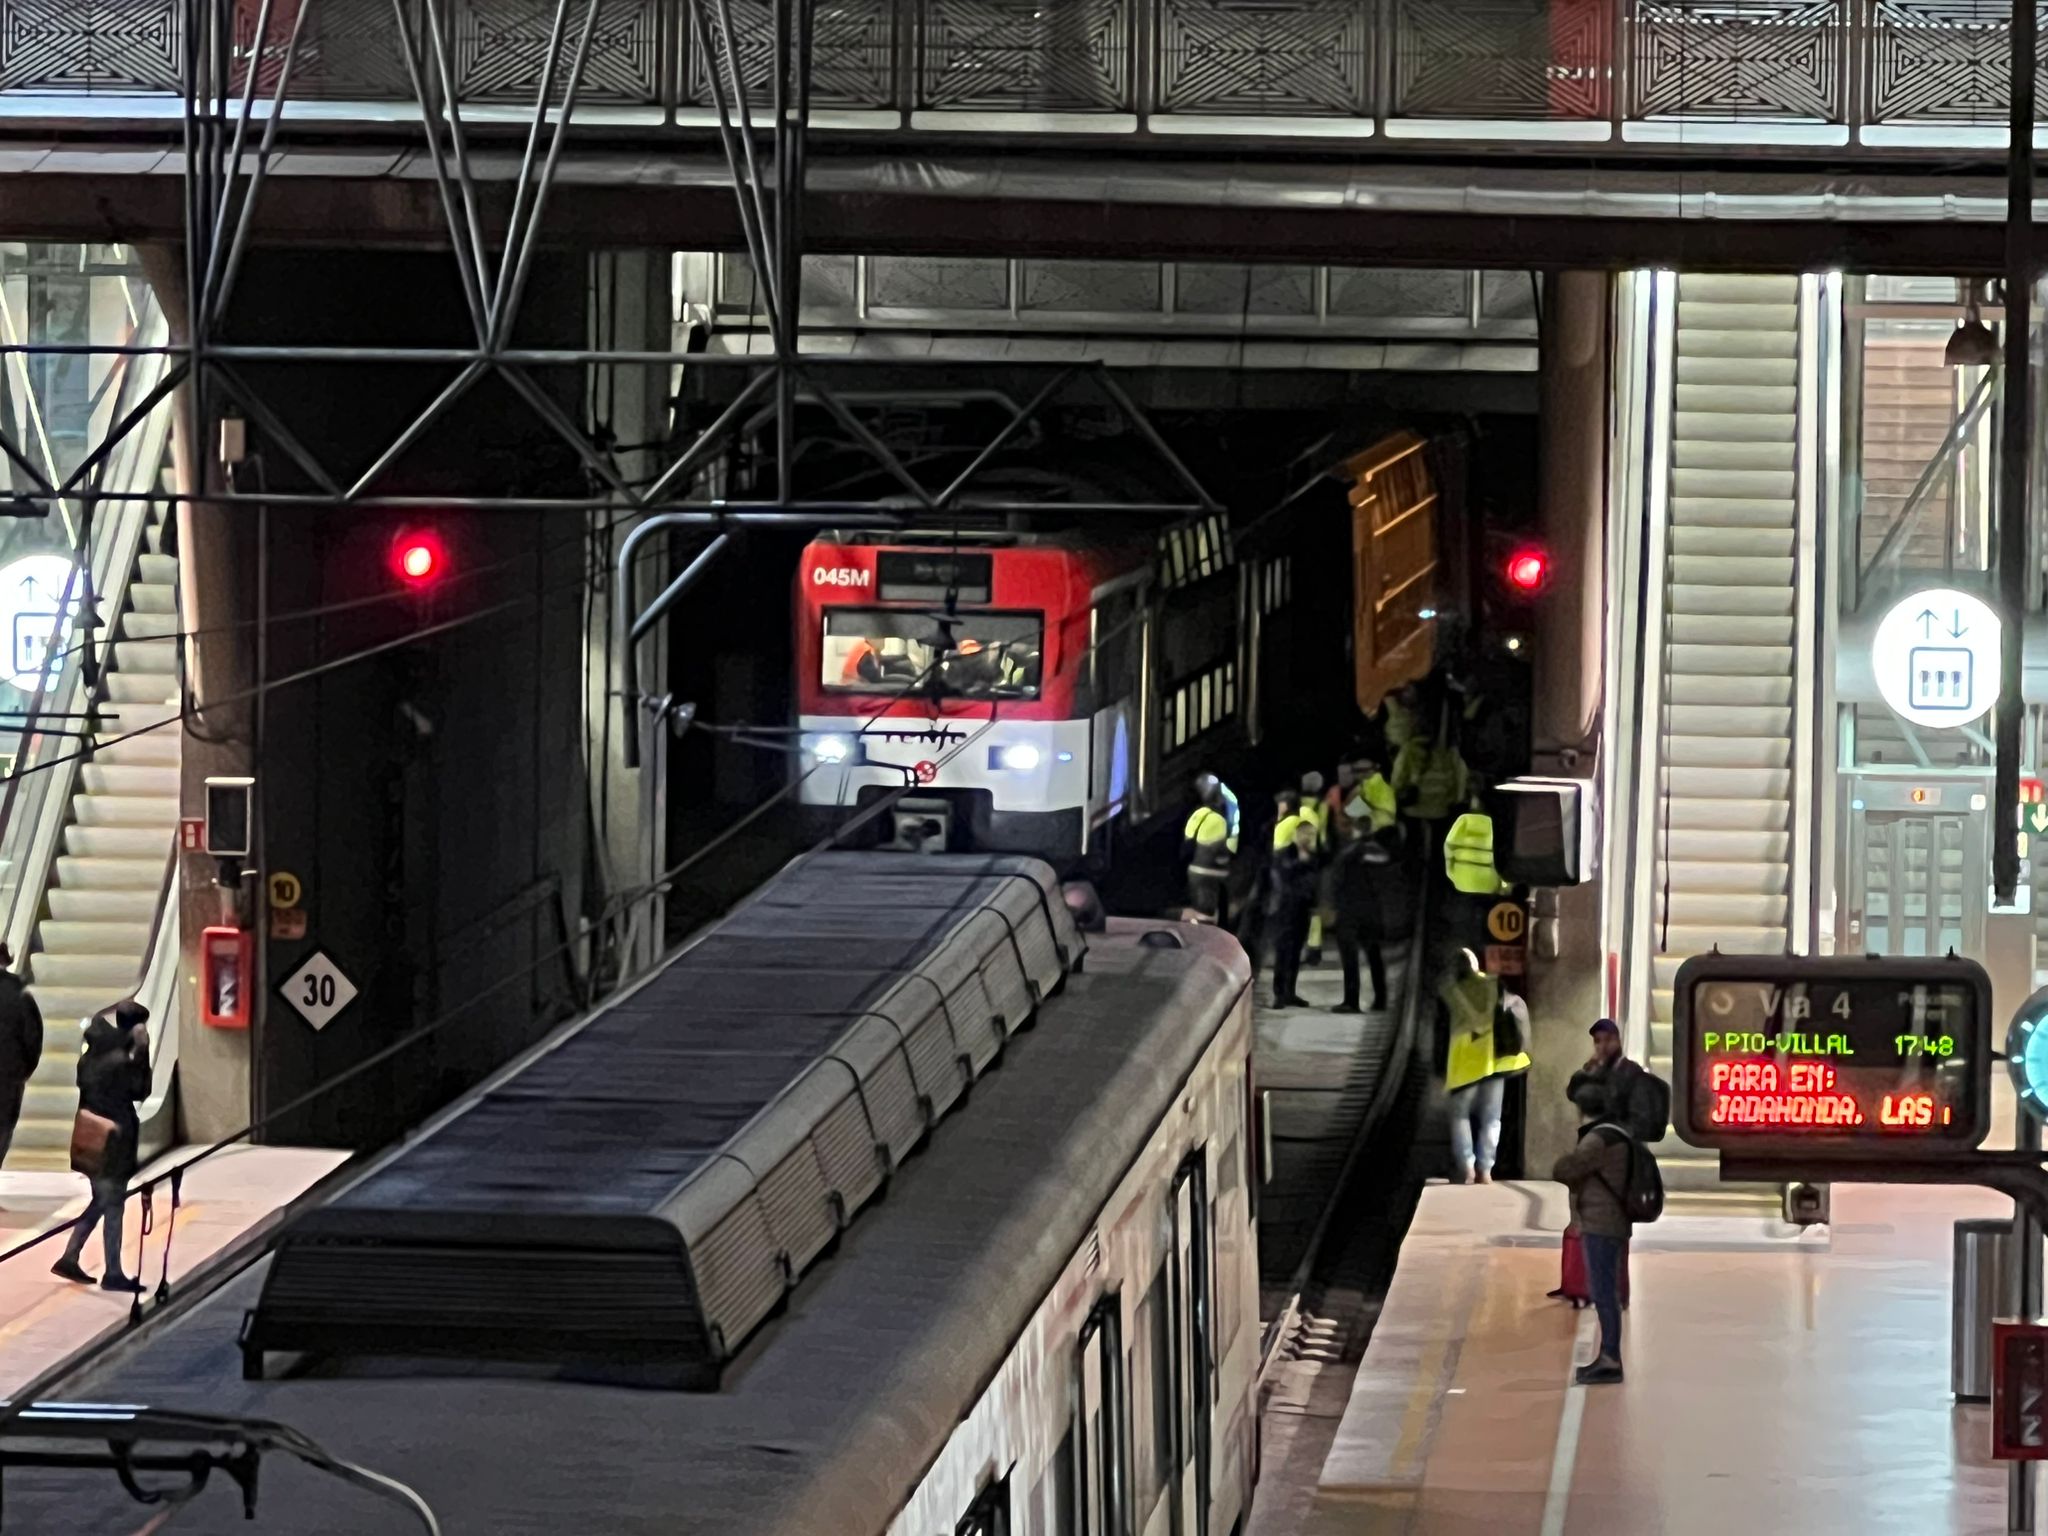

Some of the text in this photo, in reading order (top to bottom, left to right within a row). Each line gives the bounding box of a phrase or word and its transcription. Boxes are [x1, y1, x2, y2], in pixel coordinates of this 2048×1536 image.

[813, 566, 870, 586] 045M
[1496, 910, 1521, 933] 10
[302, 973, 336, 1007] 30
[1832, 991, 1851, 1019] 4
[1711, 1063, 1835, 1093] PARA EN:
[1880, 1096, 1934, 1126] LAS
